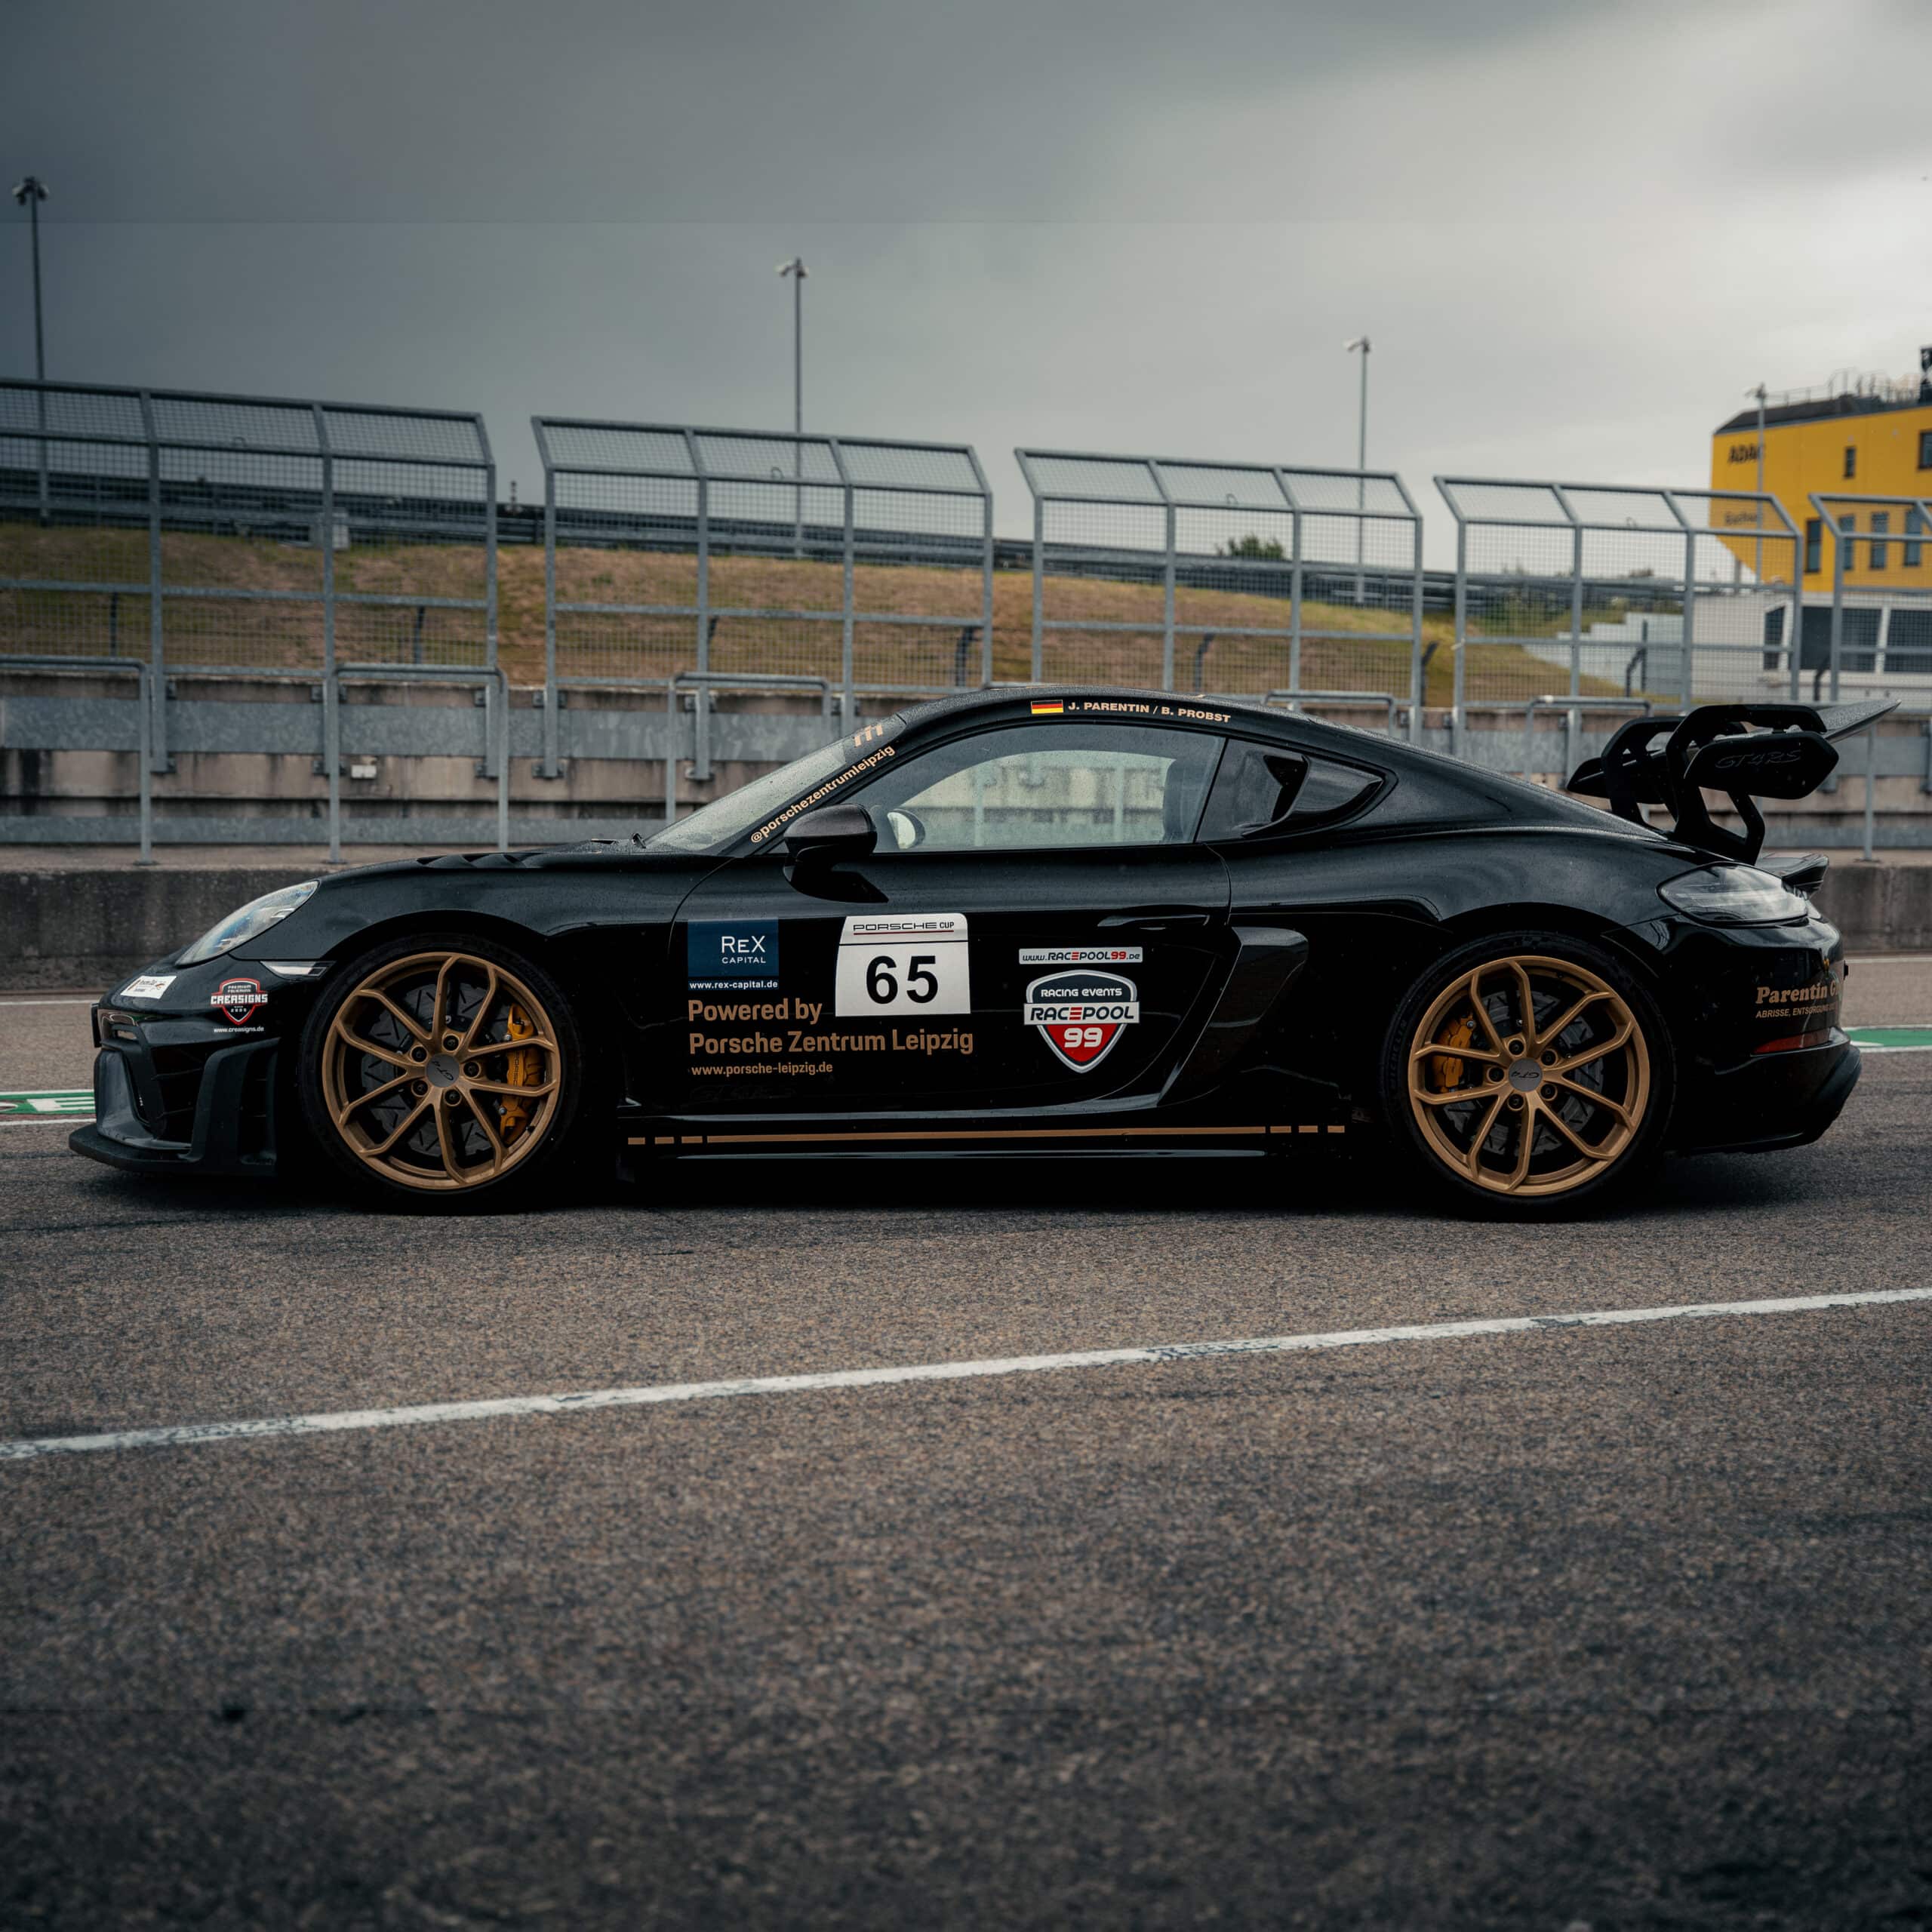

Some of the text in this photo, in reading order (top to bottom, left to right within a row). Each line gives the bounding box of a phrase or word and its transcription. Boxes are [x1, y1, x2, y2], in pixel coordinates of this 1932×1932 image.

[1084, 702, 1149, 713] PARENTIN
[1161, 706, 1174, 715] B.
[1178, 708, 1232, 723] PROBST
[750, 745, 896, 844] @porschezentrumleipzig
[853, 922, 937, 931] PORSCHE
[689, 980, 778, 989] www.rex-capital.de
[866, 955, 938, 1004] 65
[211, 993, 268, 1005] CREASIGNS
[1755, 983, 1827, 1004] Parentin
[688, 998, 823, 1025] Powered by
[1030, 1006, 1134, 1021] RACEPOOL
[1755, 1008, 1792, 1019] ABRISSE,
[689, 1028, 974, 1055] Porsche Zentrum Leipzig
[1063, 1027, 1103, 1048] 99
[691, 1061, 833, 1077] www.porsche-leipzig.de
